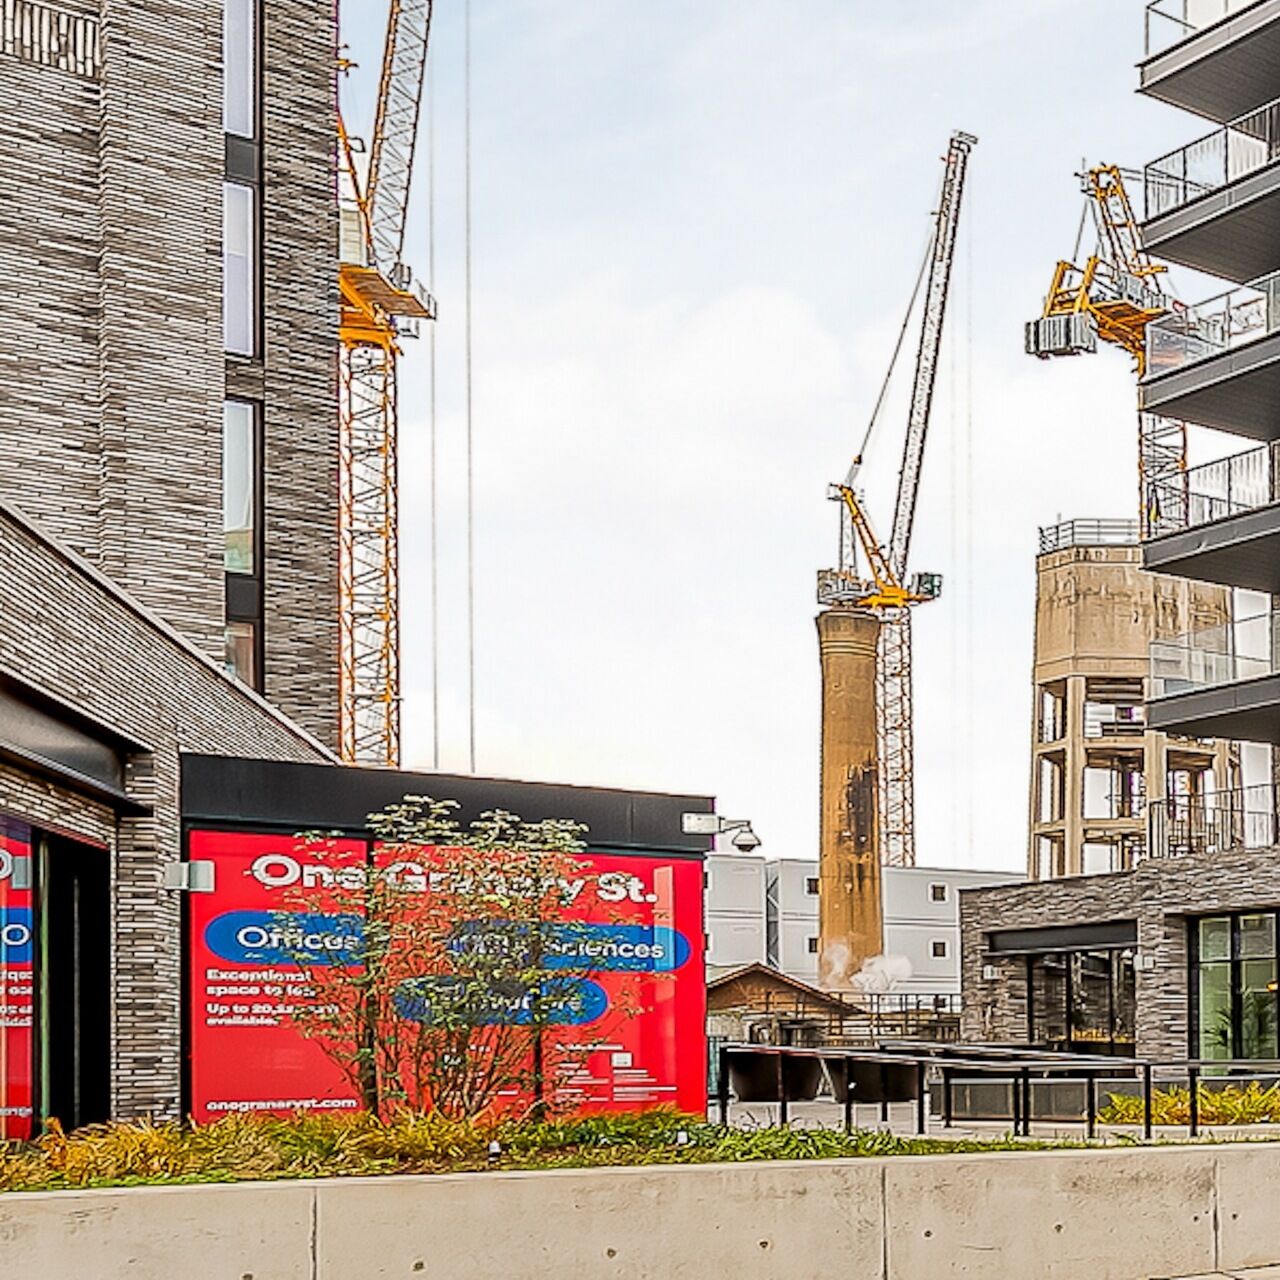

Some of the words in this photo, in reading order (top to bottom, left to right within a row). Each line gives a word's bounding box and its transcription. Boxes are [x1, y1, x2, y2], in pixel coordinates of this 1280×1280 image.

[251, 854, 367, 890] One
[597, 872, 659, 903] St.
[206, 969, 312, 982] Exceptional
[206, 985, 260, 997] space
[264, 985, 283, 996] to
[206, 1003, 230, 1016] Up
[232, 1003, 250, 1014] to
[206, 1014, 280, 1026] available.
[206, 1098, 358, 1112] onegranaryst.com
